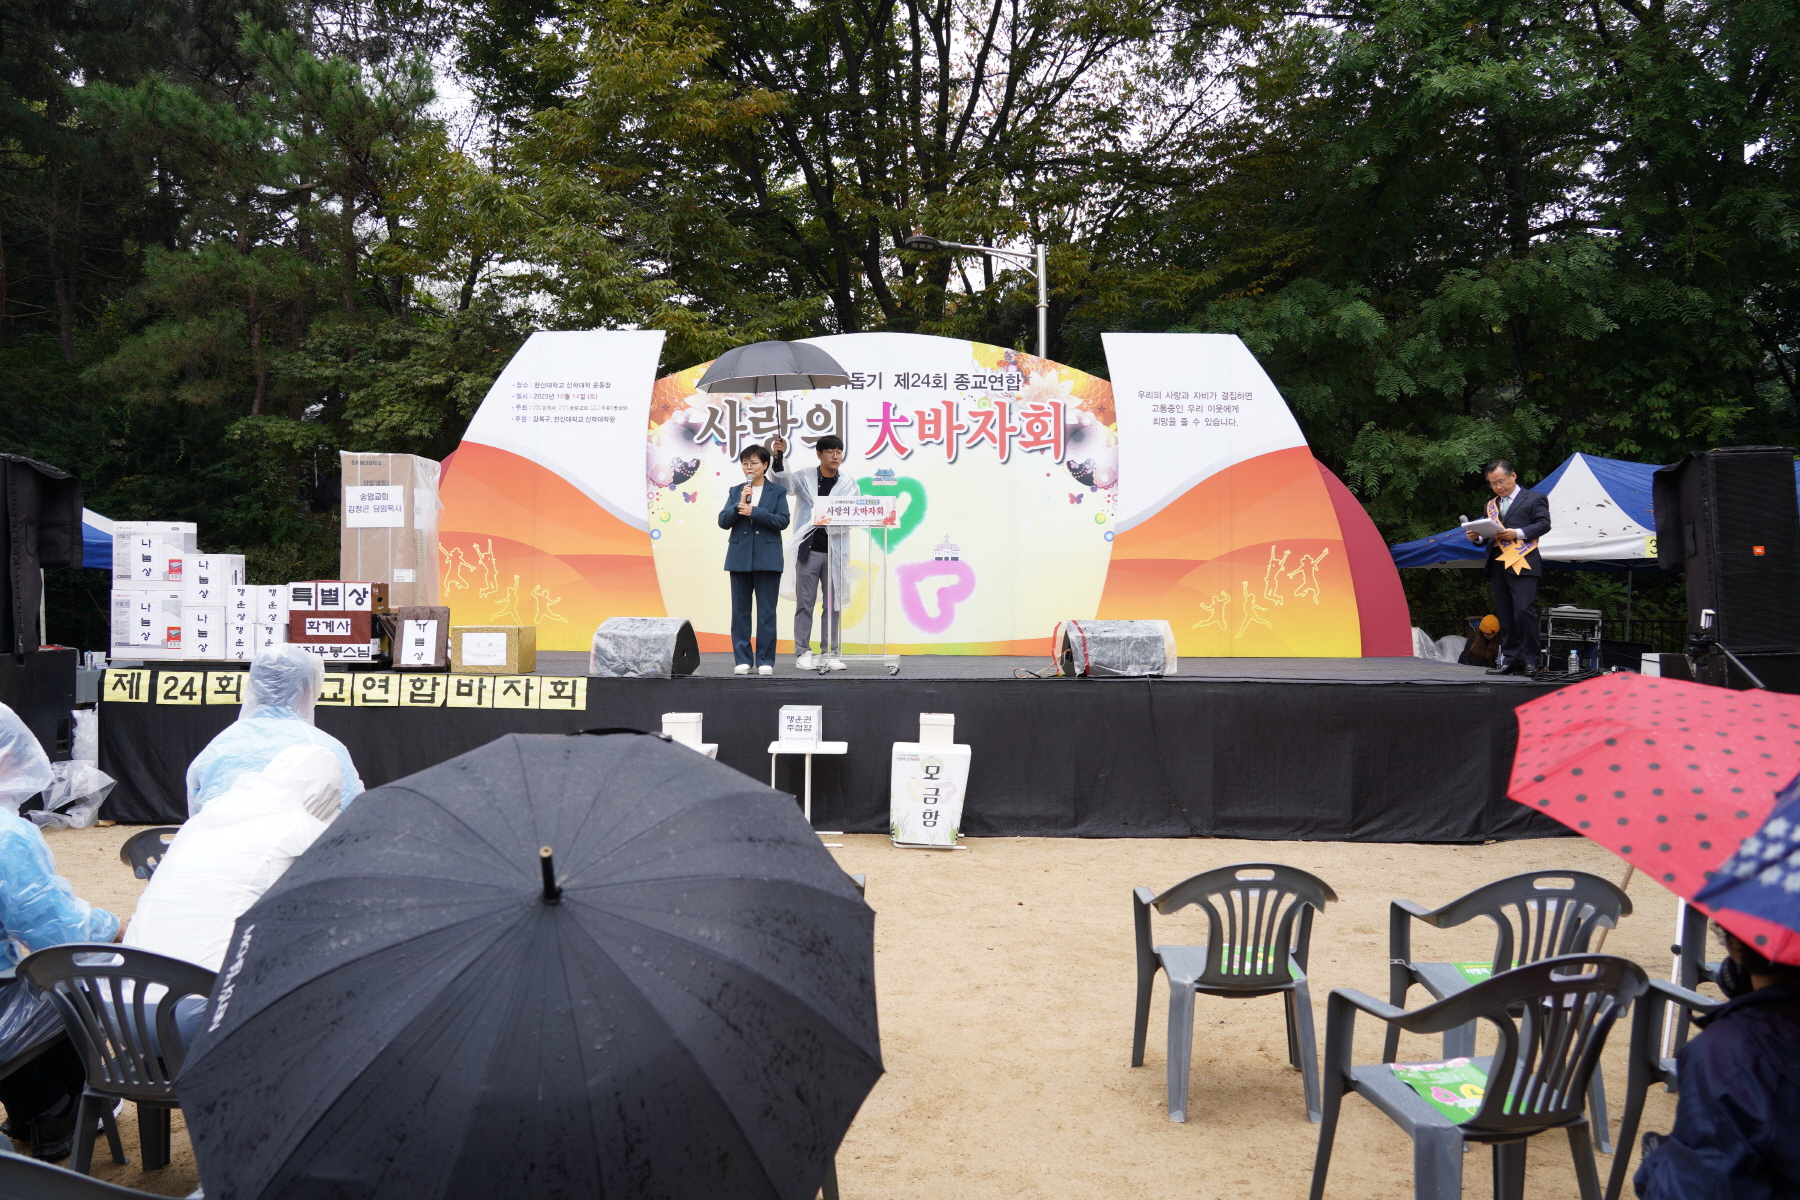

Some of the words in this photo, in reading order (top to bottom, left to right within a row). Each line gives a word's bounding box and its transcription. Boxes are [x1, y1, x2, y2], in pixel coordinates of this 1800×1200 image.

[534, 381, 565, 389] 한신대학교
[566, 381, 591, 389] 신학대학
[893, 371, 948, 391] 제24회
[953, 372, 1022, 392] 종교연합
[533, 392, 555, 401] 2023년
[556, 392, 571, 401] 10월
[572, 392, 586, 401] 14일
[587, 392, 598, 401] (토)
[1137, 390, 1162, 401] 우리의
[1165, 390, 1190, 401] 사랑과
[1193, 390, 1218, 401] 자비가
[1221, 390, 1253, 401] 결집하면
[1151, 404, 1184, 414] 고통중인
[1187, 404, 1204, 414] 우리
[1207, 404, 1240, 414] 이웃에게
[553, 415, 584, 423] 한신대학교
[585, 415, 616, 424] 신학대학원
[1152, 416, 1177, 427] 희망을
[1180, 417, 1189, 427] 줄
[1192, 417, 1201, 427] 수
[1204, 417, 1239, 427] 있습니다.
[695, 398, 846, 460] 사랑의
[863, 398, 1064, 462] 大바자회
[360, 492, 389, 502] 송암교회
[373, 504, 402, 513] 담임목사
[827, 505, 850, 517] 사랑의
[1649, 538, 1658, 555] 3
[141, 538, 152, 577] 나눔상
[198, 560, 210, 599] 나눔상
[291, 586, 370, 607] 특별상
[140, 602, 151, 642] 나눔상
[306, 620, 350, 633] 화계사
[197, 613, 209, 653] 나눔상
[264, 626, 274, 647] 행운
[296, 645, 370, 659] 지우봉스님
[111, 671, 243, 703] 제24회
[319, 675, 578, 708] 교연합바자회
[922, 765, 941, 828] 모금함
